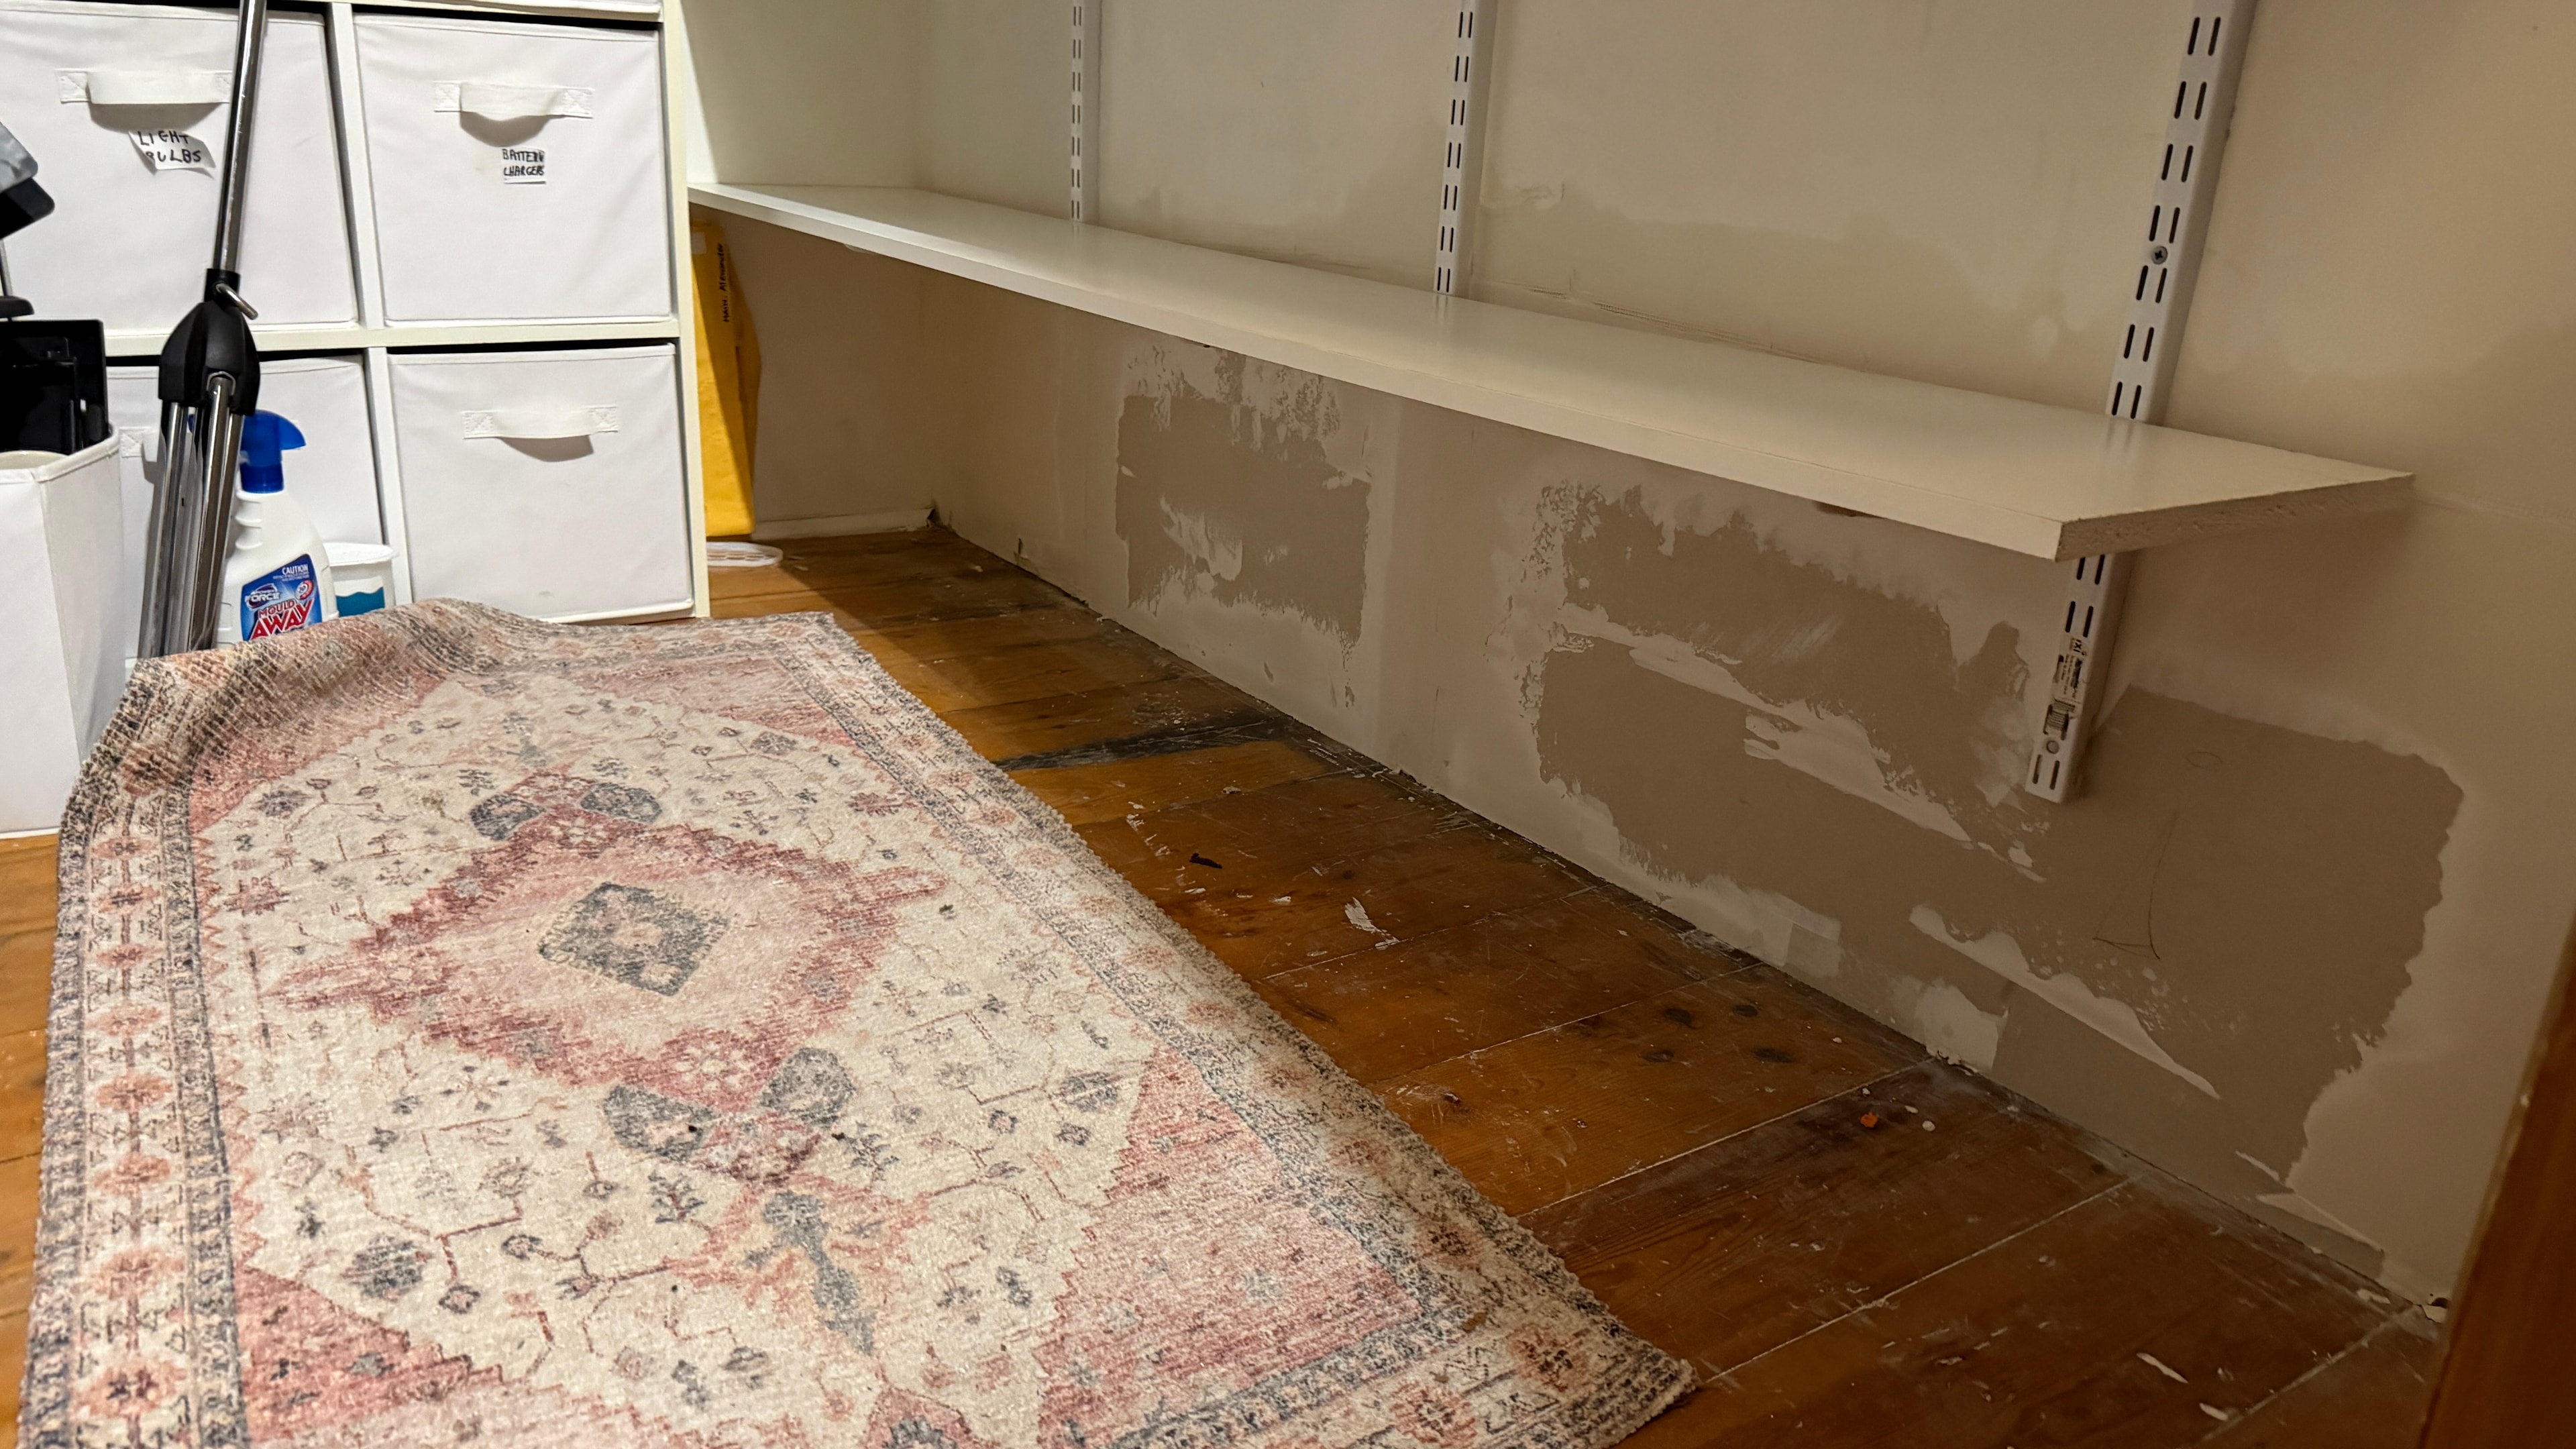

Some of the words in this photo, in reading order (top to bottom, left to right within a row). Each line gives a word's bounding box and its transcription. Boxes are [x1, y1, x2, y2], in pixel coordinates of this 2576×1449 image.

[138, 131, 189, 146] LIGHT
[282, 564, 309, 575] CAUTION
[244, 592, 280, 602] FORCE
[258, 600, 296, 619] MOULD
[249, 598, 315, 641] AWAY
